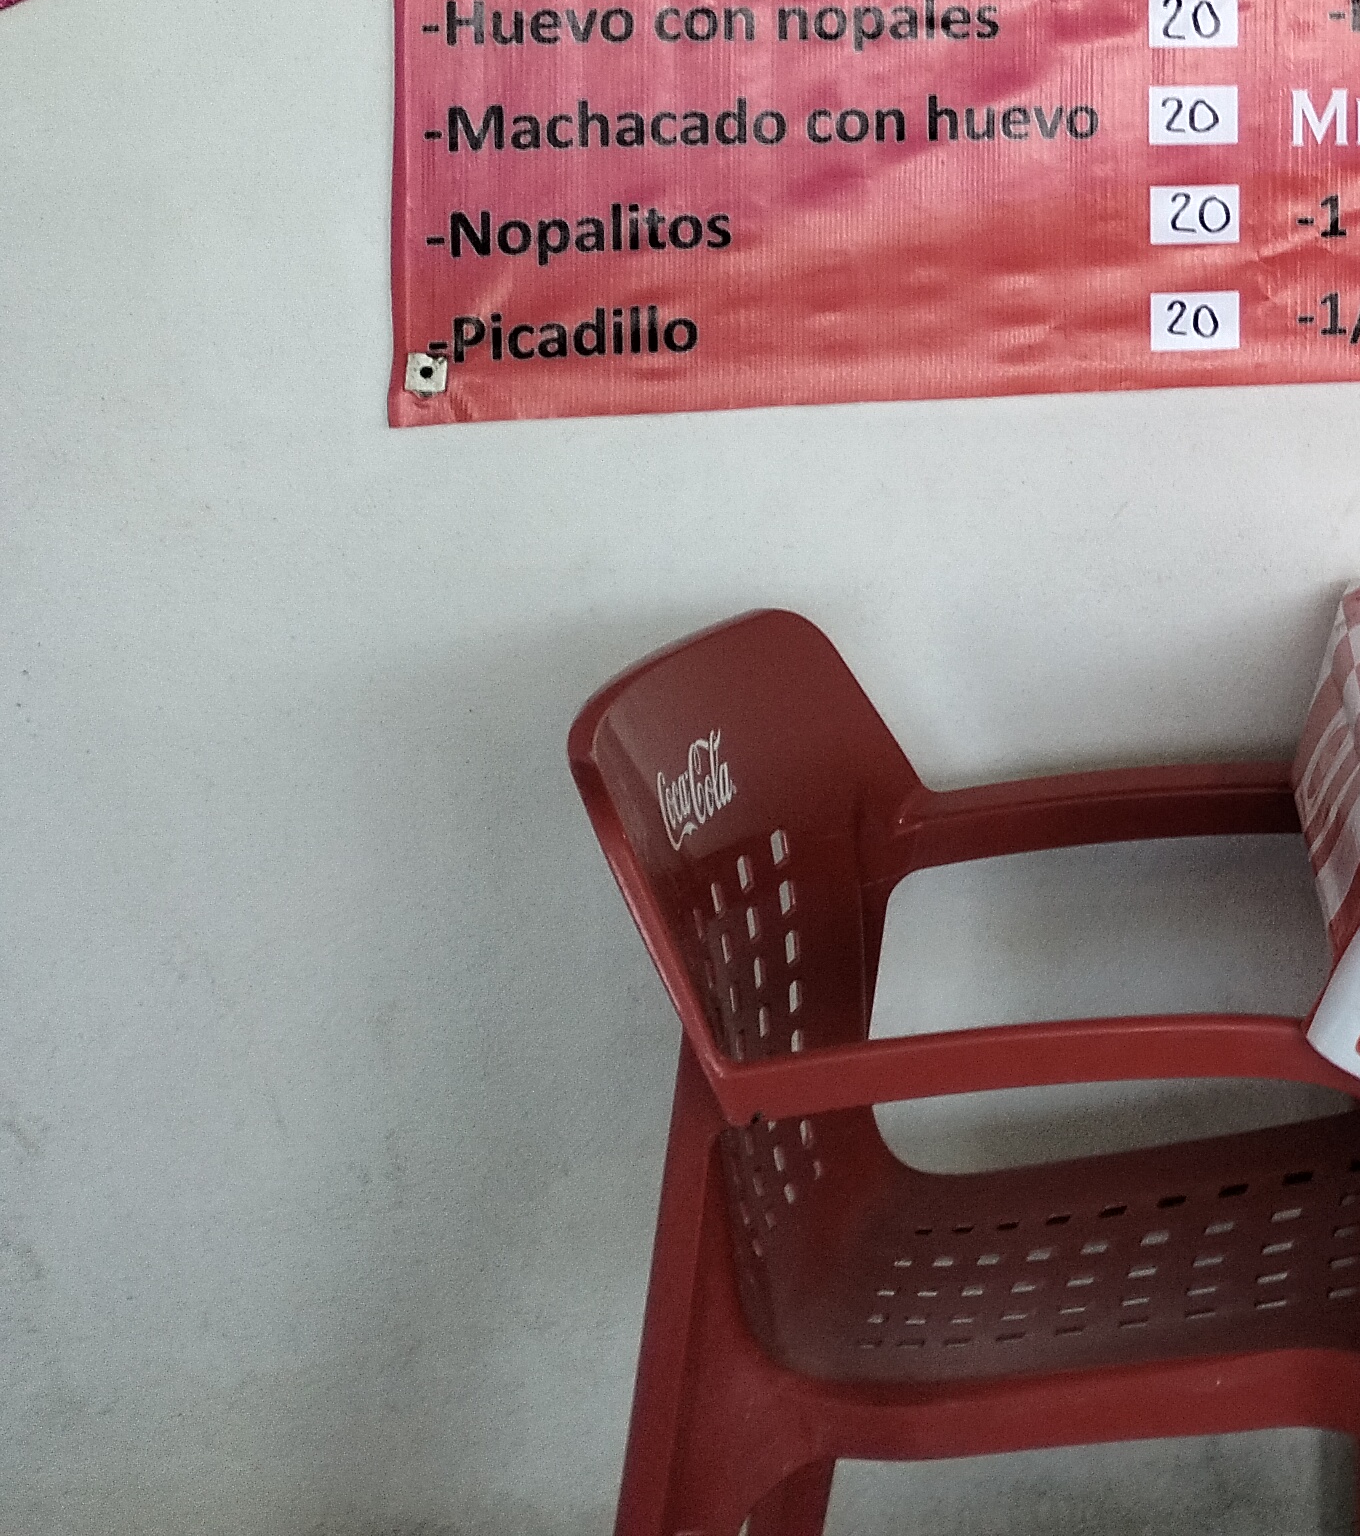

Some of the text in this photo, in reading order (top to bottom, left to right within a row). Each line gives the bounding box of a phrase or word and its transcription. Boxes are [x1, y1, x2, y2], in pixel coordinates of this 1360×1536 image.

[806, 105, 906, 145] con
[928, 95, 1100, 143] huevo
[1162, 98, 1219, 133] 20
[1170, 193, 1230, 234] 20
[1166, 300, 1219, 338] 20
